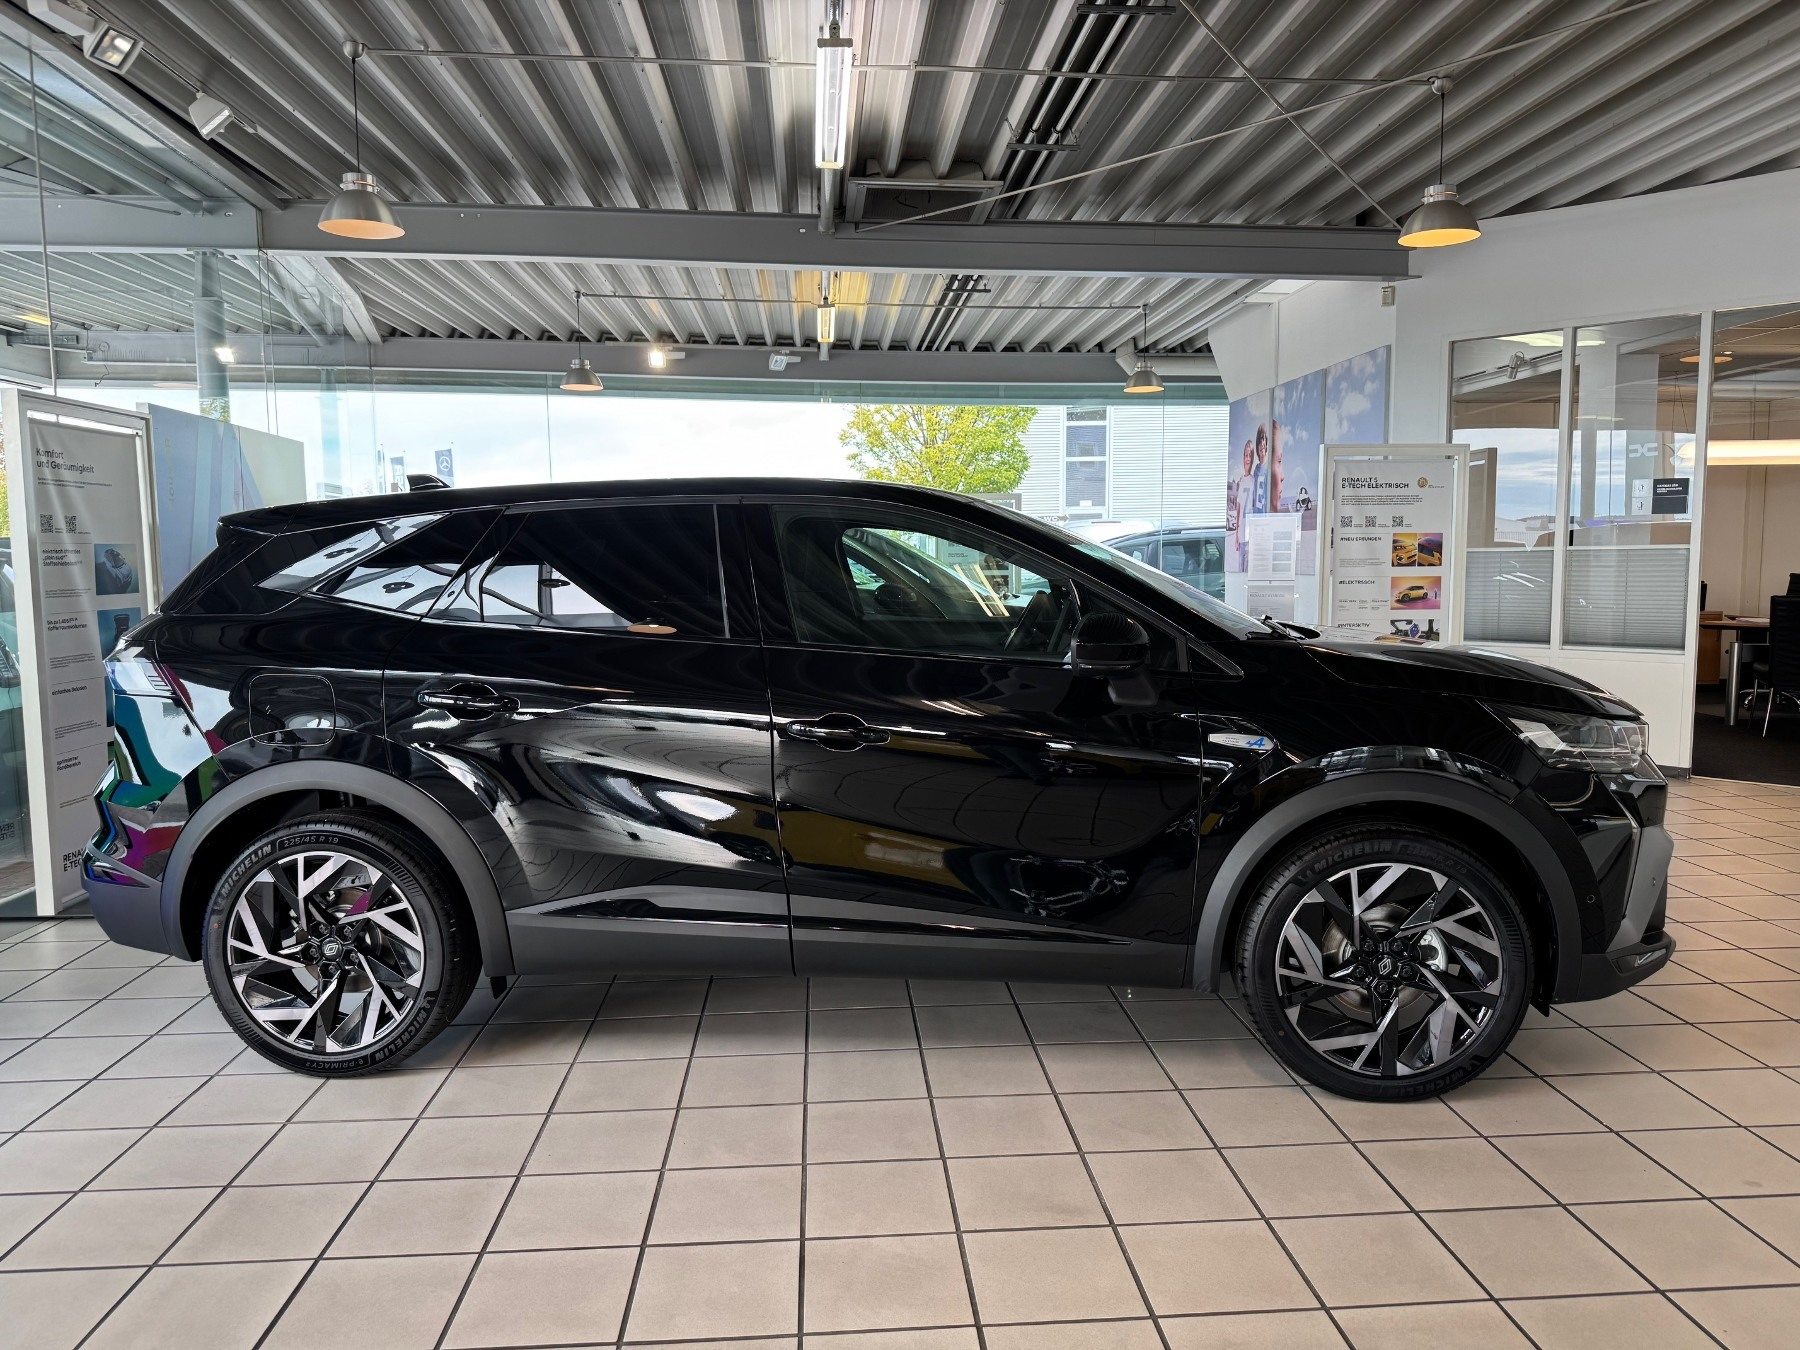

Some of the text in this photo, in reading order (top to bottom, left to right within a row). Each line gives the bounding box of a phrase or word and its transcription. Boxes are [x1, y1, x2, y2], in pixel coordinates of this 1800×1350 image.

[36, 447, 64, 459] Komfort
[36, 459, 95, 474] und Geräumigkeit
[63, 848, 83, 863] RENA
[1314, 839, 1393, 872] MICHELIN
[63, 860, 83, 872] E-TEC
[221, 844, 272, 898] MICHELIN
[284, 836, 316, 848] 225/45
[328, 836, 339, 844] 19
[374, 1009, 427, 1062] MICHELIN
